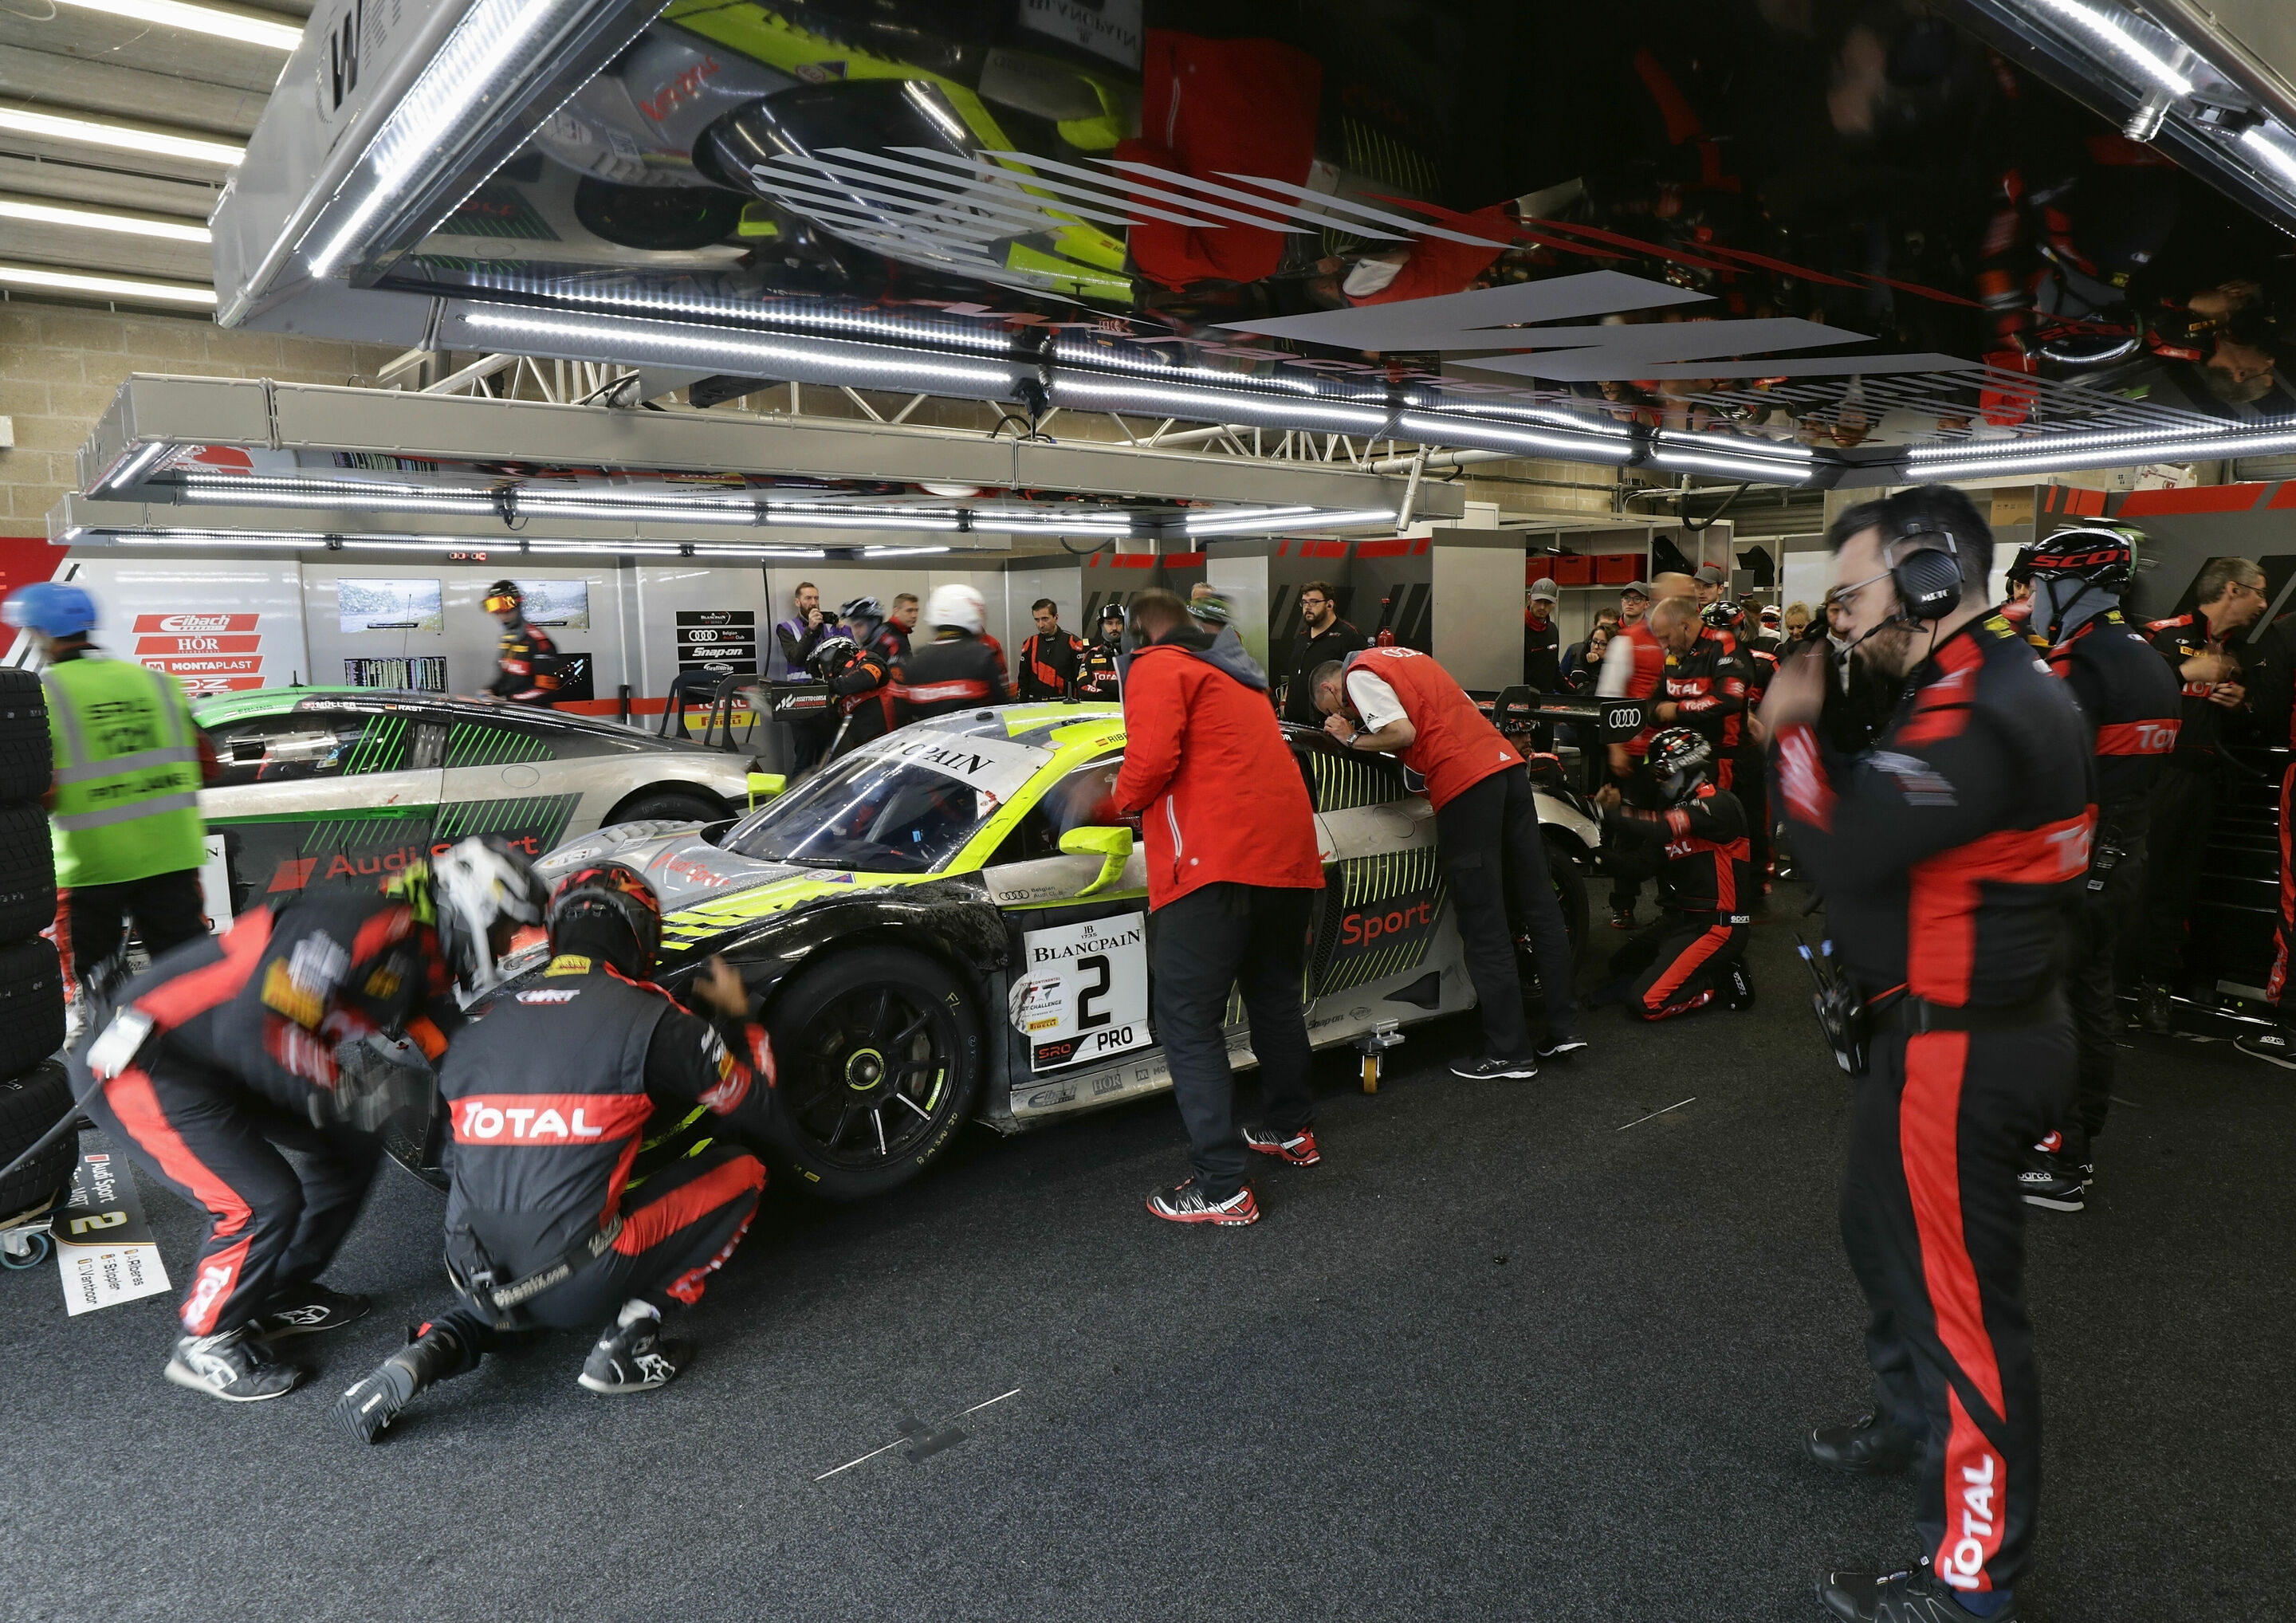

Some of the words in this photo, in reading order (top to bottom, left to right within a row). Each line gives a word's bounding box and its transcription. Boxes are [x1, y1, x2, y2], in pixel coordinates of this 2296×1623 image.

[160, 615, 230, 631] Eibach
[177, 635, 219, 650] HÖR
[692, 647, 743, 658] Snap-on
[171, 661, 253, 670] MONTAPLAST
[325, 846, 416, 879] Audi
[1342, 901, 1431, 947] Sport
[1033, 929, 1142, 963] BLANCPAIN
[1077, 954, 1111, 1032] 2
[1030, 1000, 1063, 1011] CHALLENGE
[1030, 1019, 1057, 1031] PIRELLI
[1307, 1014, 1345, 1030] Snap-on
[1097, 1026, 1134, 1051] PRO
[1038, 1043, 1071, 1059] SRO
[462, 1100, 603, 1140] TOTAL
[92, 1162, 111, 1181] Audi
[92, 1178, 118, 1204] Sport
[70, 1211, 128, 1235] 2
[1944, 1453, 1994, 1589] TOTAL
